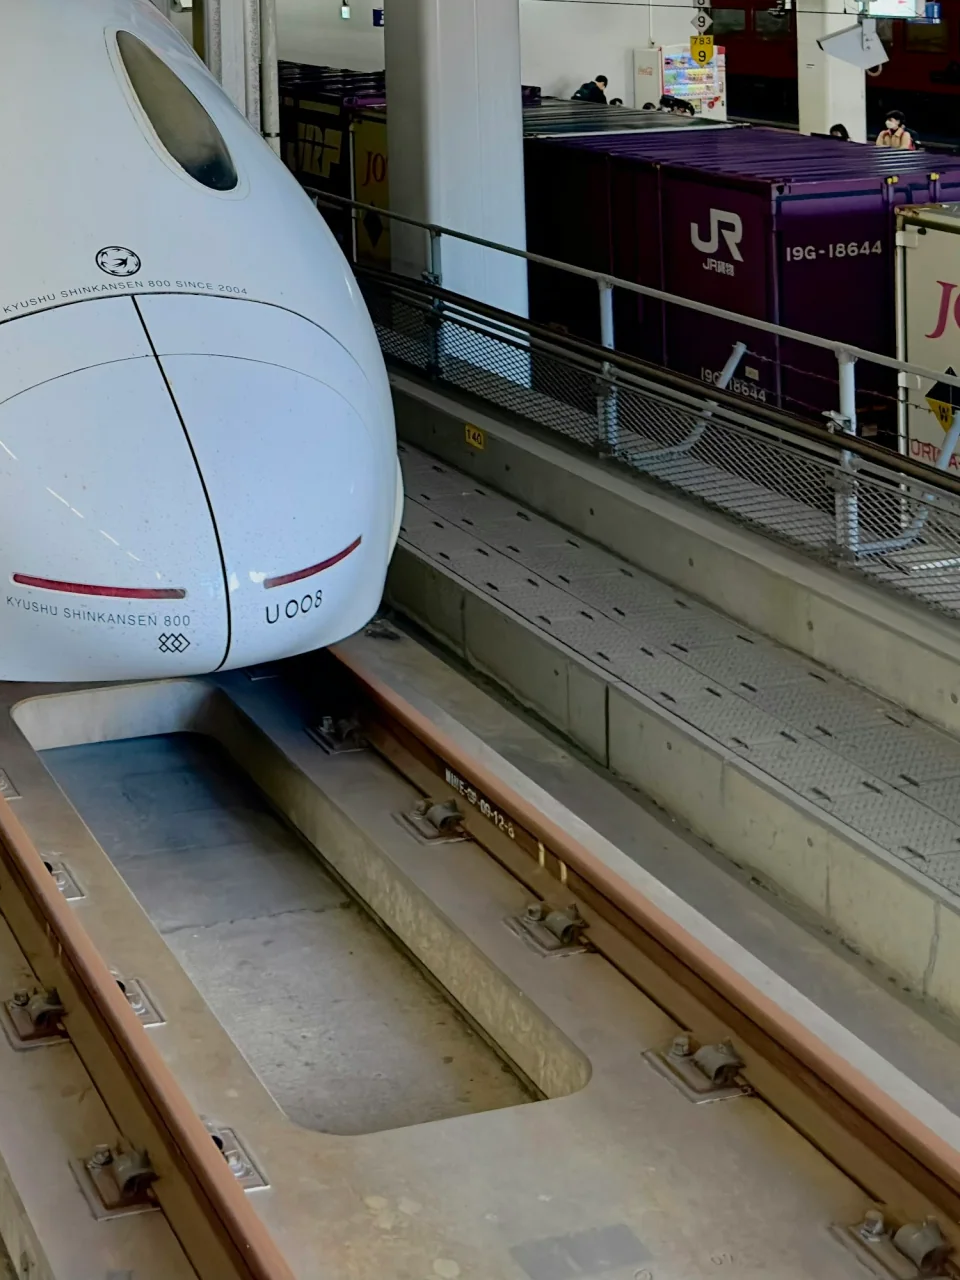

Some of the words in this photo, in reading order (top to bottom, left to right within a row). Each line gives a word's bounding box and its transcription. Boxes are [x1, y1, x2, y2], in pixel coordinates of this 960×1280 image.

[697, 16, 706, 28] 9
[693, 37, 711, 45] 783
[698, 50, 707, 62] 9
[362, 150, 388, 187] JO
[690, 208, 744, 262] JR
[786, 240, 883, 262] 19G-18644
[3, 293, 56, 314] KYUSHU
[60, 281, 144, 298] SHINKANSEN
[148, 280, 171, 288] 800
[176, 280, 214, 290] SINCE
[218, 284, 248, 295] 2004
[924, 280, 960, 339] J
[6, 595, 58, 616] KYUSHU
[63, 607, 158, 627] SHINKANSEN
[163, 615, 191, 627] 800
